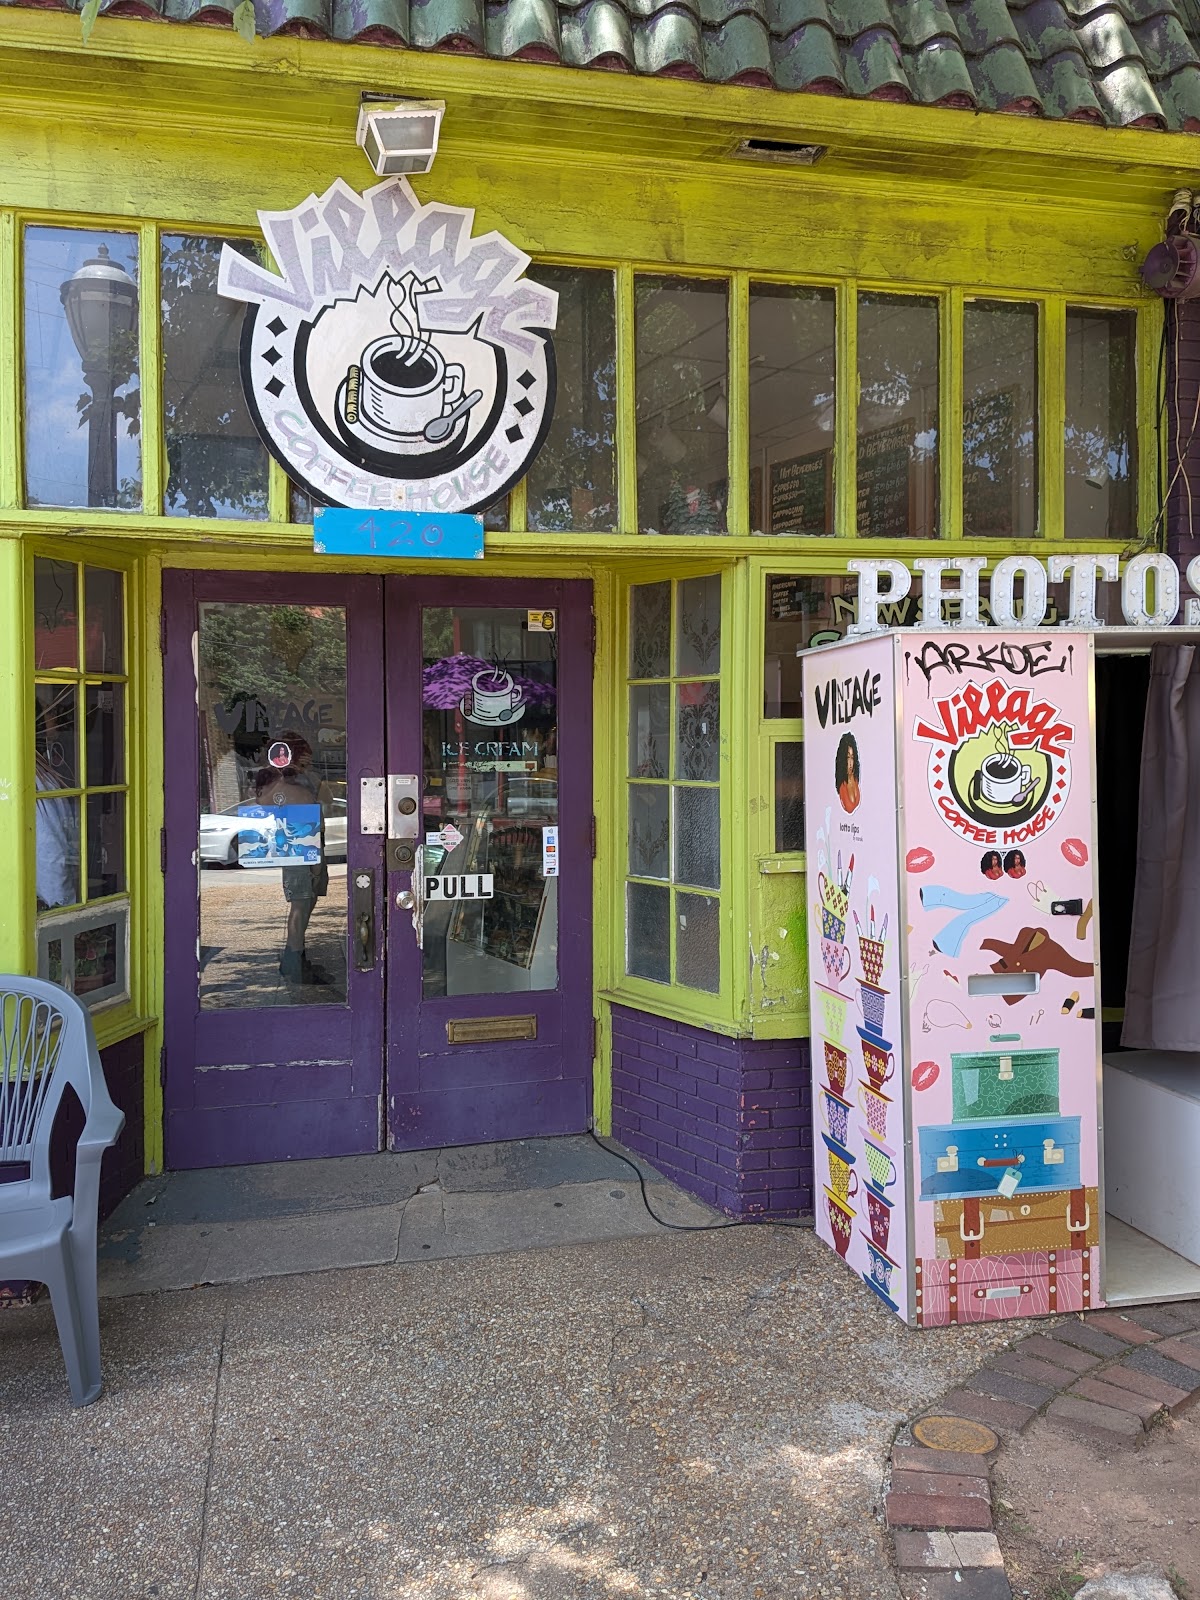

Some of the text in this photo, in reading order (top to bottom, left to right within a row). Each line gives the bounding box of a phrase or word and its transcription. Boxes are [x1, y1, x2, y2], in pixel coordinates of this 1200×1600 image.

[275, 409, 510, 509] COFFEE HOUSE
[847, 553, 1200, 635] PHOTO
[441, 741, 539, 757] ICE CREAM
[917, 680, 1073, 759] Village
[937, 795, 1056, 845] COFFEE HOUSE
[425, 875, 492, 900] PULL
